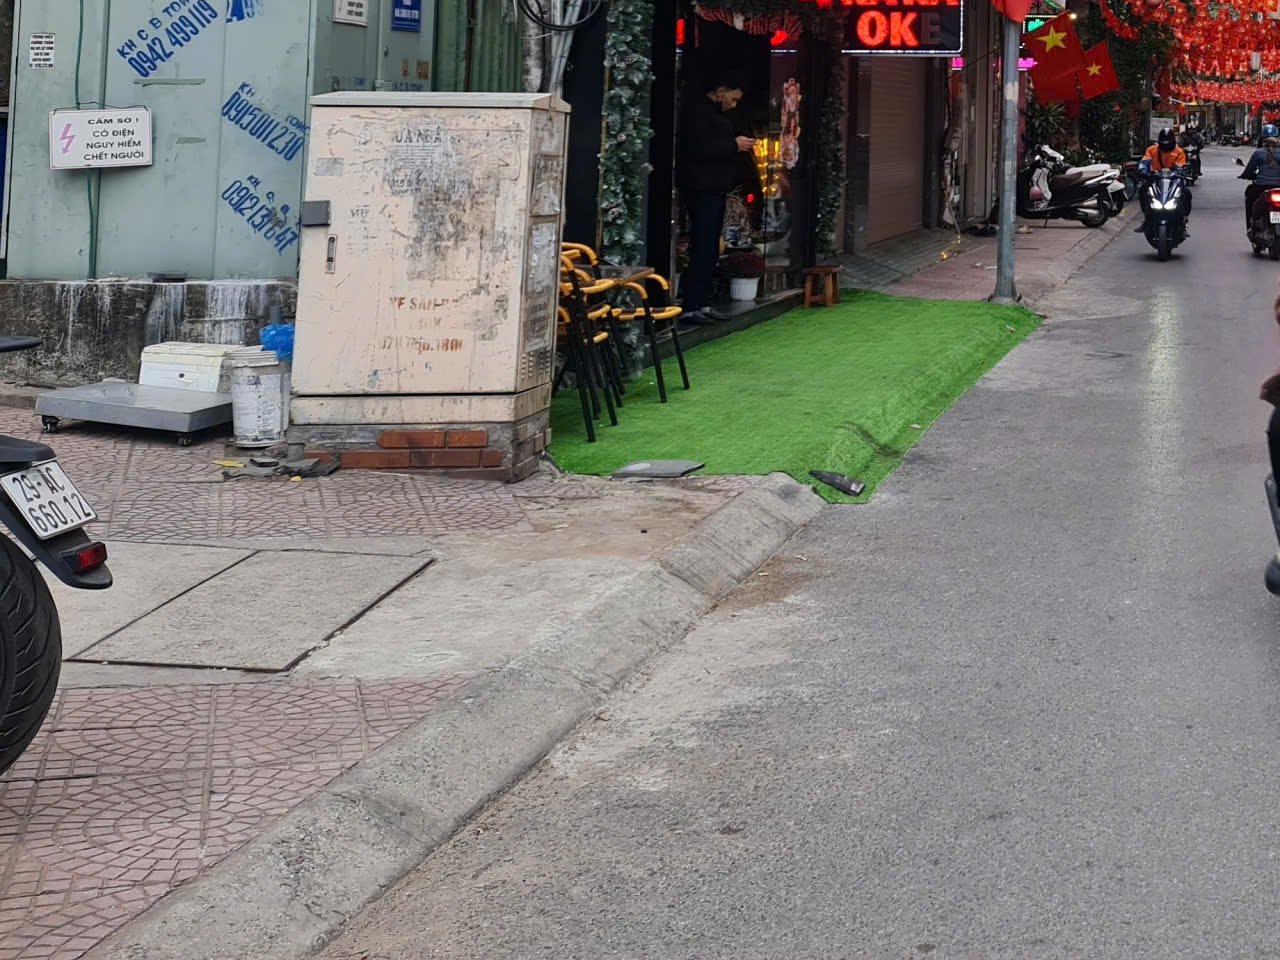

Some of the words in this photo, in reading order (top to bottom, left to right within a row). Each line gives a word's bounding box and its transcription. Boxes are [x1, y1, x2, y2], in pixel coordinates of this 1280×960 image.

[116, 38, 137, 59] KH
[92, 128, 109, 138] CÓ
[111, 127, 135, 138] ĐIỆN
[86, 141, 115, 150] NGUY
[117, 138, 141, 148] HIỂM
[83, 150, 109, 161] CHẾT
[110, 150, 144, 160] NGƯỜI
[28, 492, 91, 533] 660.12
